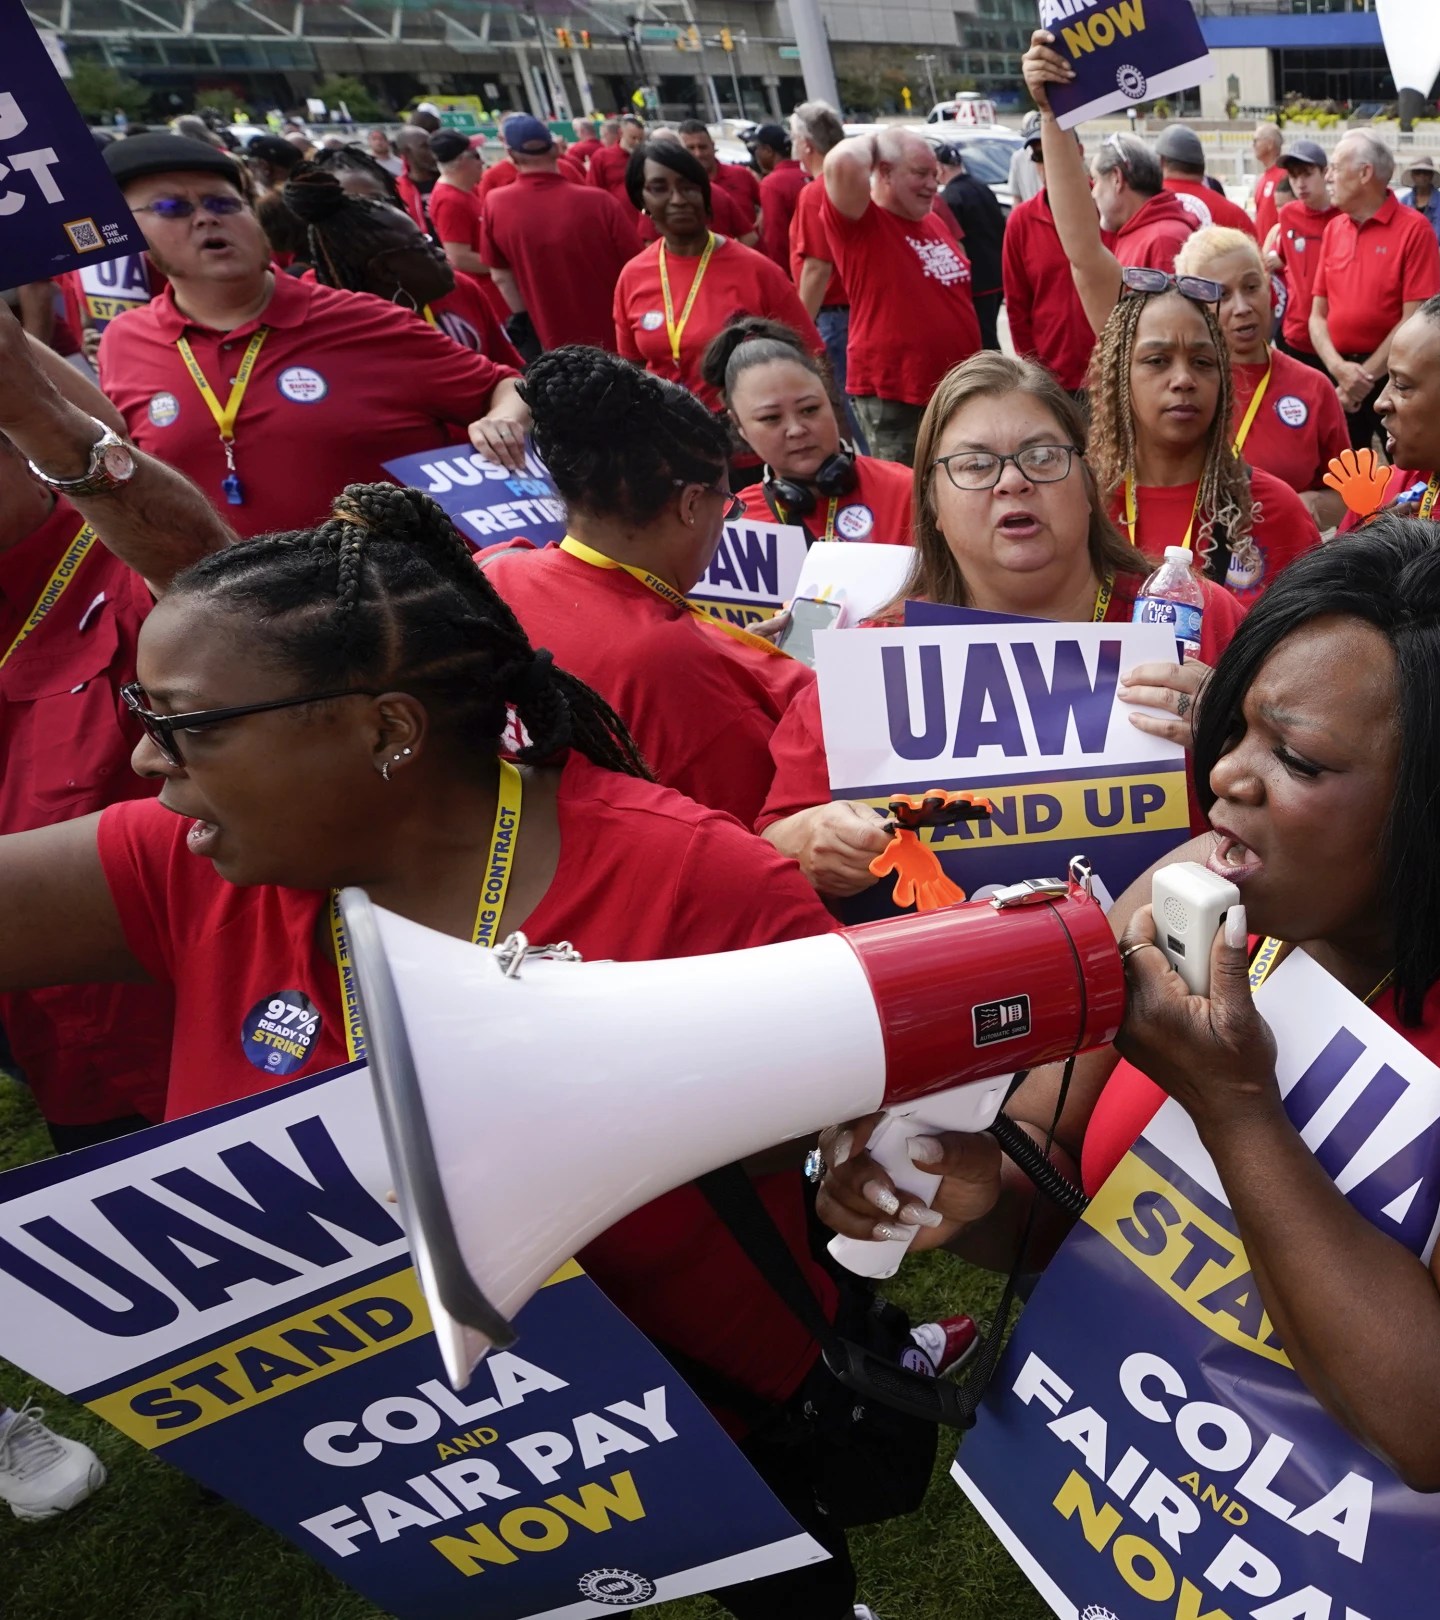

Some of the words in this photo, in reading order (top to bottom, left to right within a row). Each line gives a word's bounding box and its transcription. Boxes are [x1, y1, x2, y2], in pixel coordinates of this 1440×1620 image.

[1061, 0, 1146, 59] NOW
[102, 223, 119, 233] JOIN
[104, 229, 119, 238] THE
[107, 234, 129, 245] FIGHT
[97, 254, 150, 293] UA
[93, 299, 133, 316] STA
[461, 498, 566, 536] RETI
[698, 527, 779, 596] AW
[30, 579, 64, 627] STRONG
[645, 574, 695, 611] FIGHTIN
[1148, 602, 1173, 615] Pure
[698, 606, 764, 629] AND
[1149, 610, 1169, 624] Life
[881, 640, 1122, 760] UAW
[1084, 783, 1167, 829] UP
[484, 806, 516, 905] CONTRACT
[475, 910, 497, 948] ONG
[1250, 936, 1283, 987] RONG
[258, 1019, 297, 1040] READY
[296, 1033, 311, 1047] TO
[264, 999, 319, 1035] 97%
[980, 1029, 1011, 1042] AUTOMATIC
[1011, 1025, 1027, 1035] SIREN
[252, 1029, 307, 1060] STRIKE
[0, 1115, 409, 1339] UAW
[1116, 1190, 1288, 1350] STA
[130, 1295, 414, 1429] STAND
[302, 1350, 570, 1468] COLA
[436, 1426, 499, 1461] AND
[1012, 1351, 1202, 1555] FAIR
[1118, 1352, 1374, 1564] COLA
[299, 1457, 521, 1557] FAIR
[506, 1385, 679, 1485] PAY
[1178, 1471, 1249, 1527] AND
[429, 1470, 648, 1577] NOW
